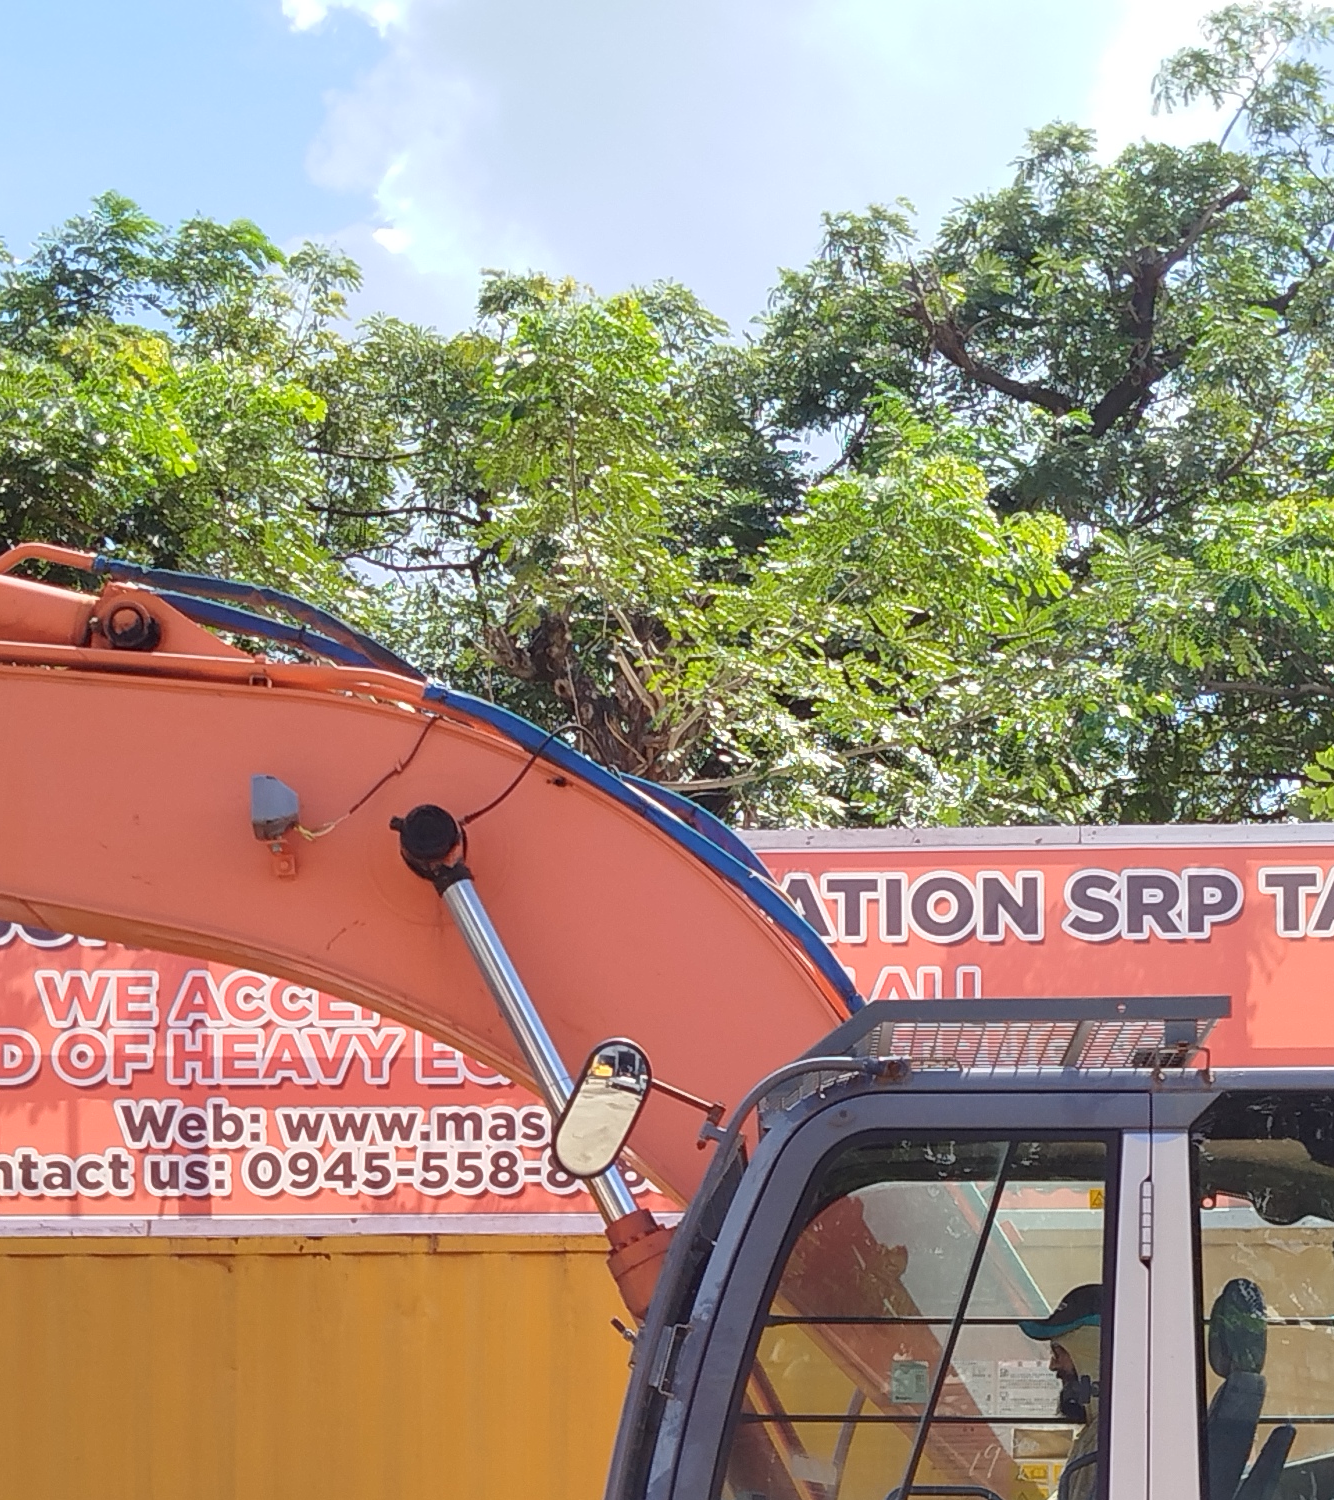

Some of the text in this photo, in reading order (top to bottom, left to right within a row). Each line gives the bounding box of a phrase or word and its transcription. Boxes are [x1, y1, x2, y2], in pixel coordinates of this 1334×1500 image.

[1064, 868, 1243, 941] SRP
[35, 970, 159, 1028] WE
[52, 1027, 155, 1085] OF
[167, 1028, 405, 1085] HEAVY
[115, 1099, 267, 1148] Web:
[143, 1150, 232, 1196] us:
